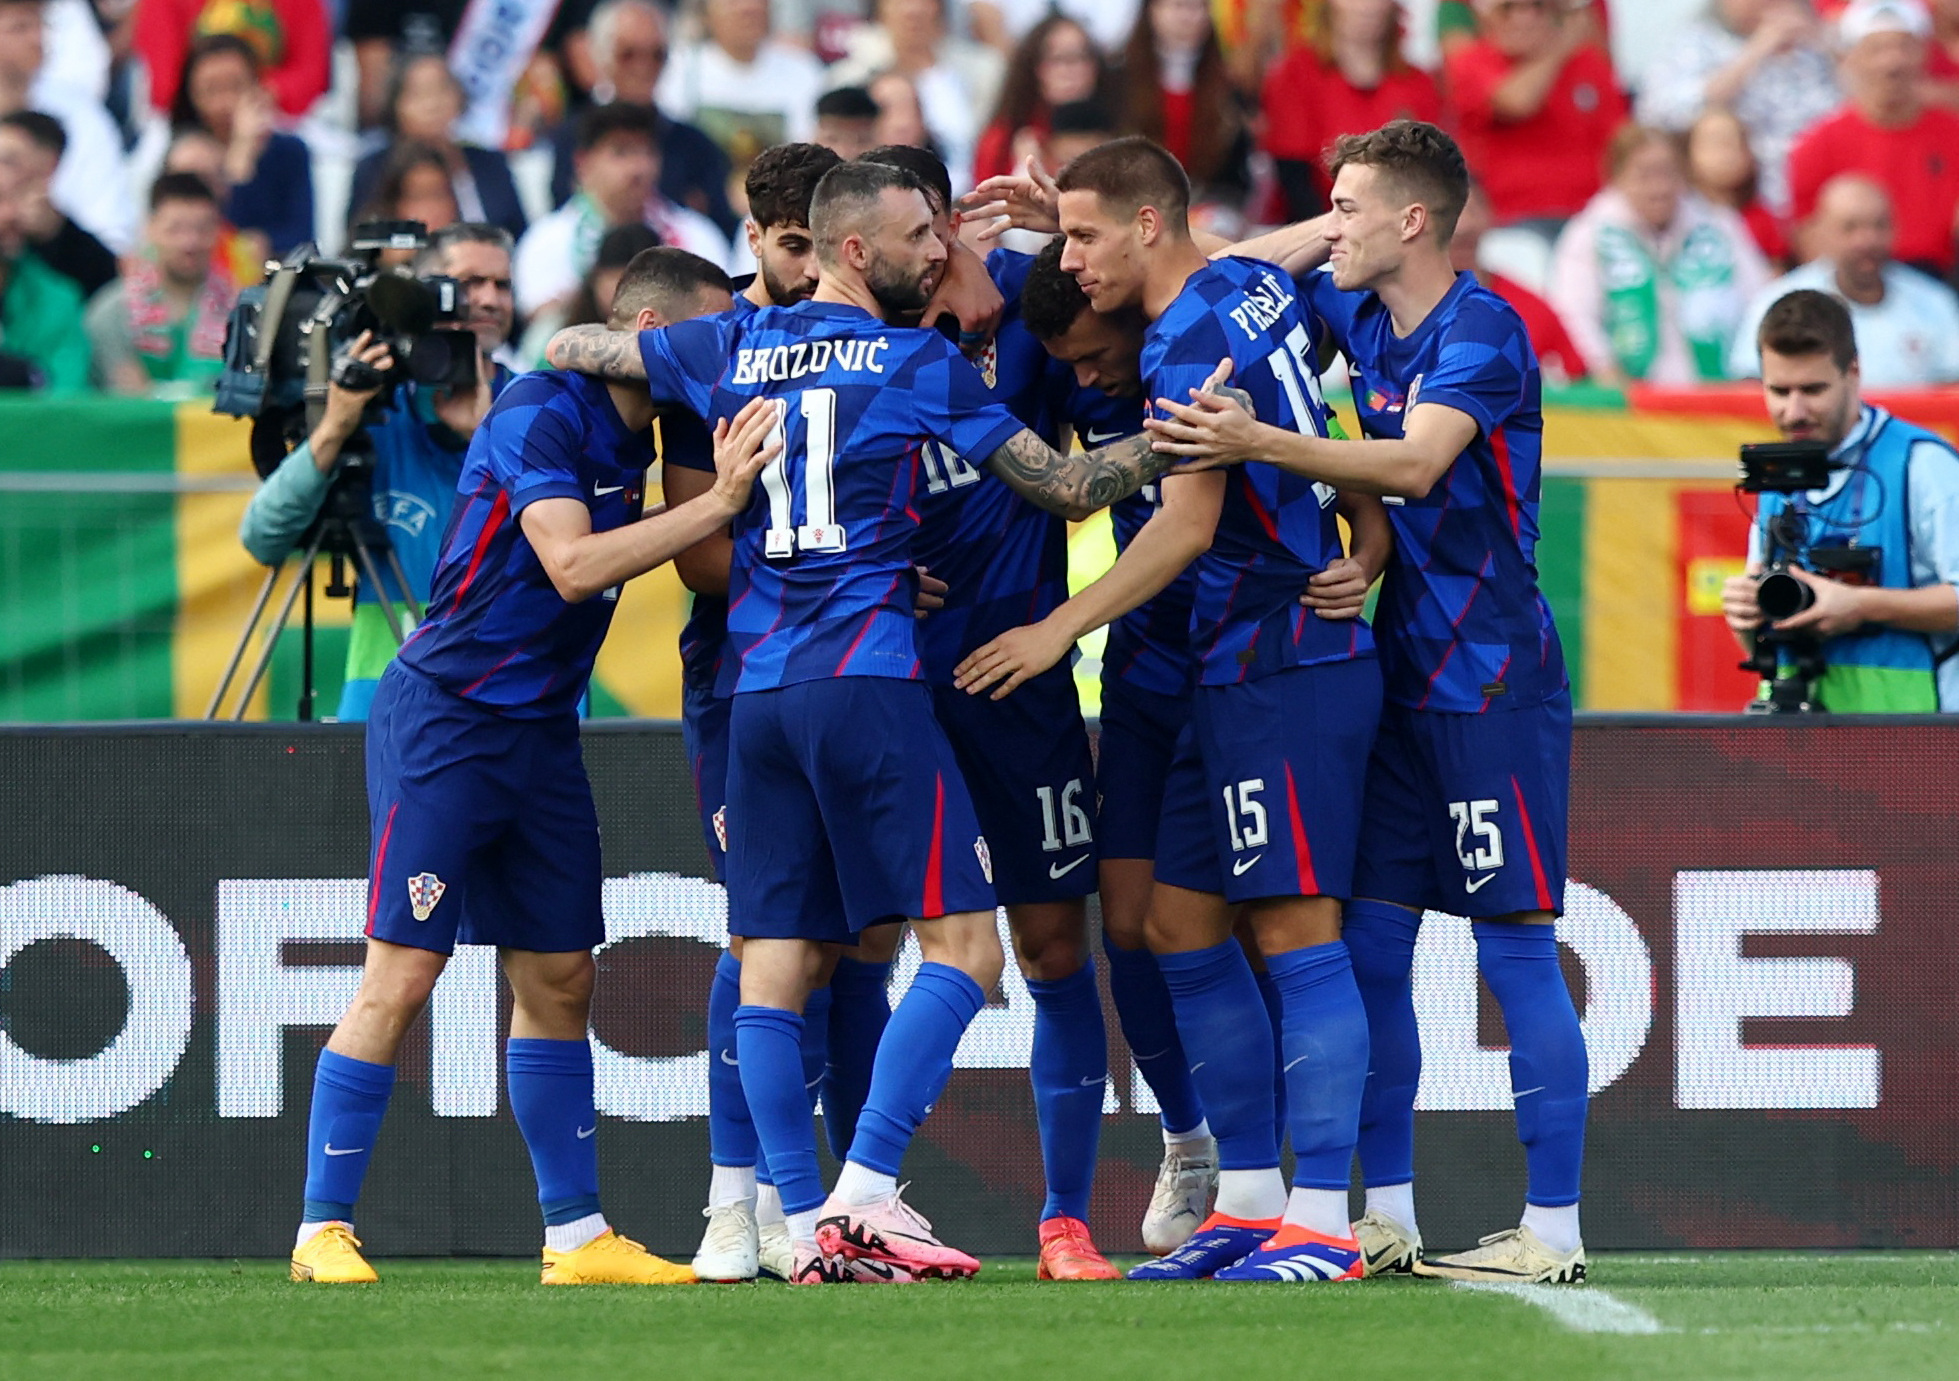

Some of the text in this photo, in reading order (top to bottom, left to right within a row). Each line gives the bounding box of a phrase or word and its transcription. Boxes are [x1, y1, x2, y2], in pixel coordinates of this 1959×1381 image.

[731, 336, 889, 384] BROZOVIĆ
[760, 387, 847, 558] 11
[1036, 778, 1093, 851] 16
[1223, 778, 1268, 851] 15
[1448, 799, 1504, 870] 25
[1410, 868, 1883, 1112] DE
